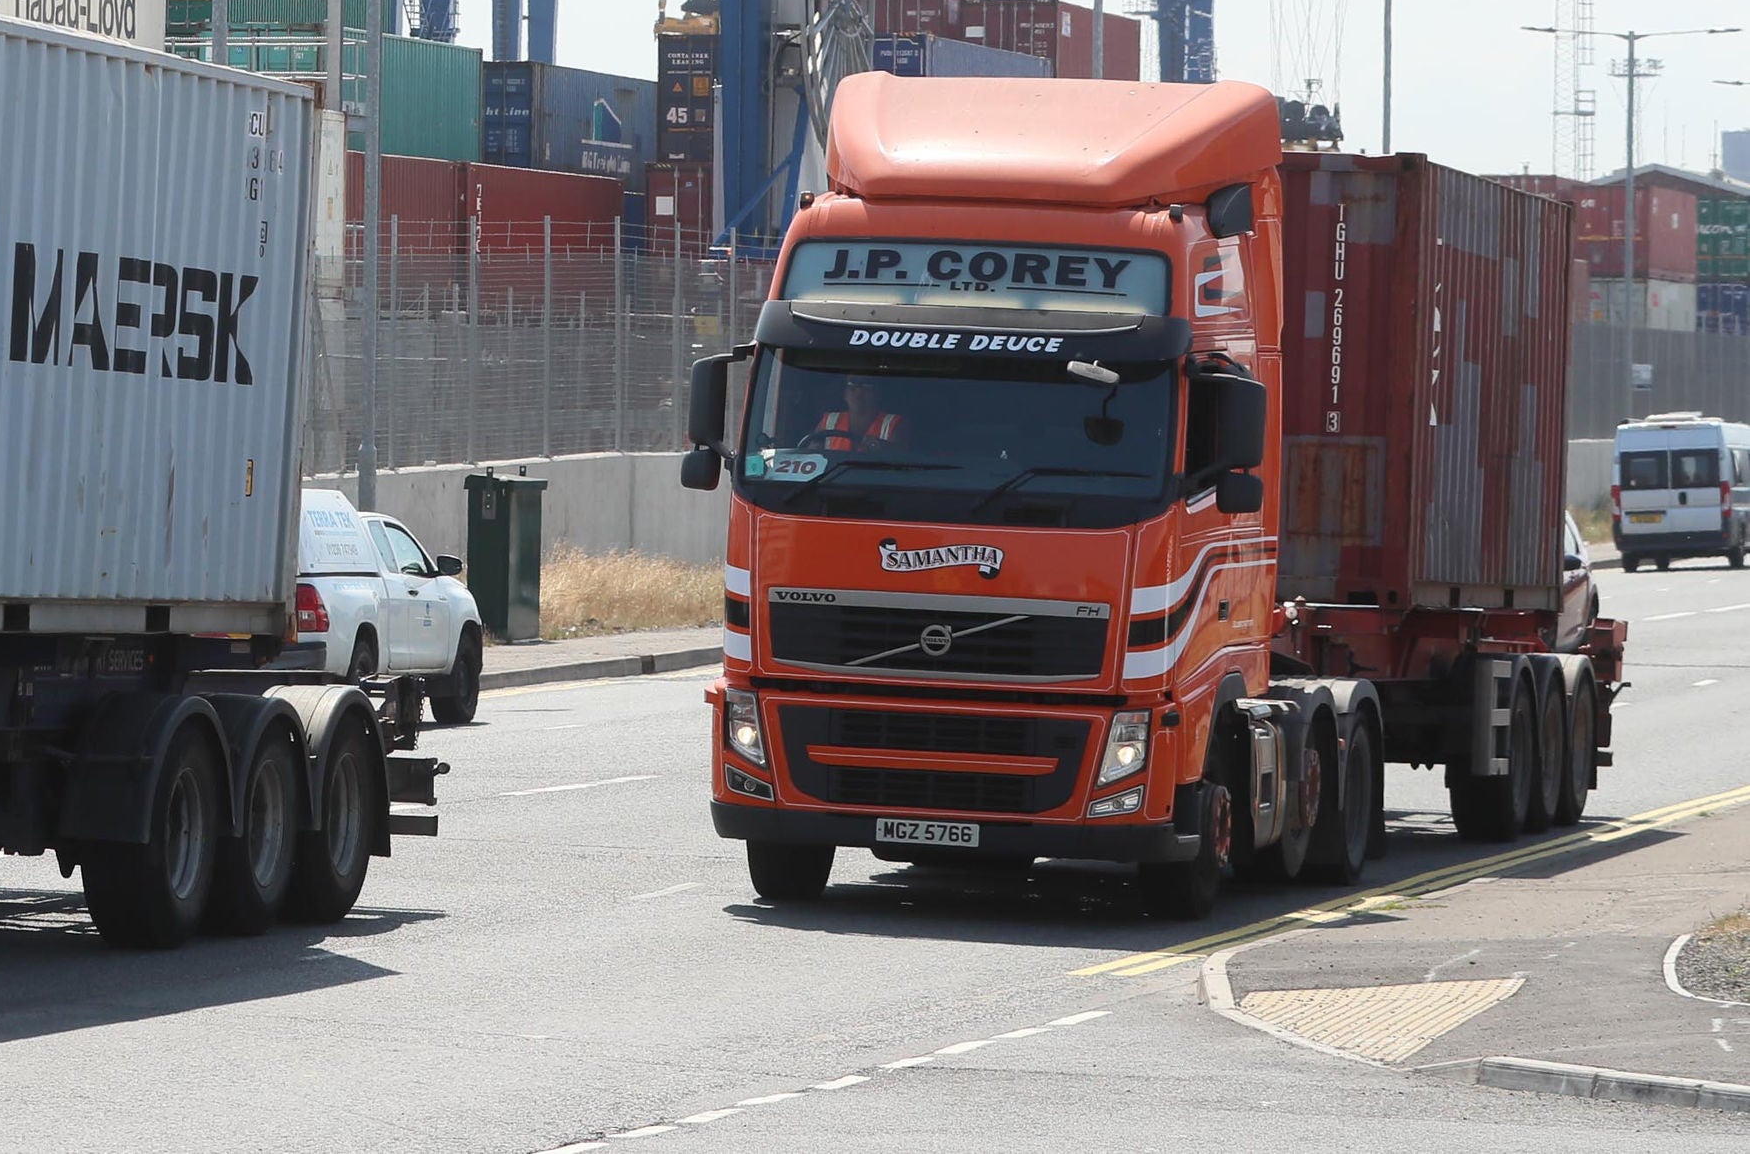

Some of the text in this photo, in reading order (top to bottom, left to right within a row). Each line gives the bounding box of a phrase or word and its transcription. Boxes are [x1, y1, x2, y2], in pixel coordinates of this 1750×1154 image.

[666, 107, 688, 124] 45
[1333, 204, 1348, 283] TGHU
[822, 249, 1133, 289] J.P. COREY
[949, 280, 996, 294] LTD.
[8, 241, 260, 386] MAERSK
[850, 328, 1064, 354] DOUBLE DEUCE
[1327, 288, 1345, 404] 269691
[774, 460, 818, 475] 210
[886, 545, 999, 569] SAMANTHA
[774, 590, 837, 604] VOLVO
[1075, 605, 1101, 617] FH
[921, 635, 950, 645] VOLVO
[883, 820, 974, 845] MGZ 5766
